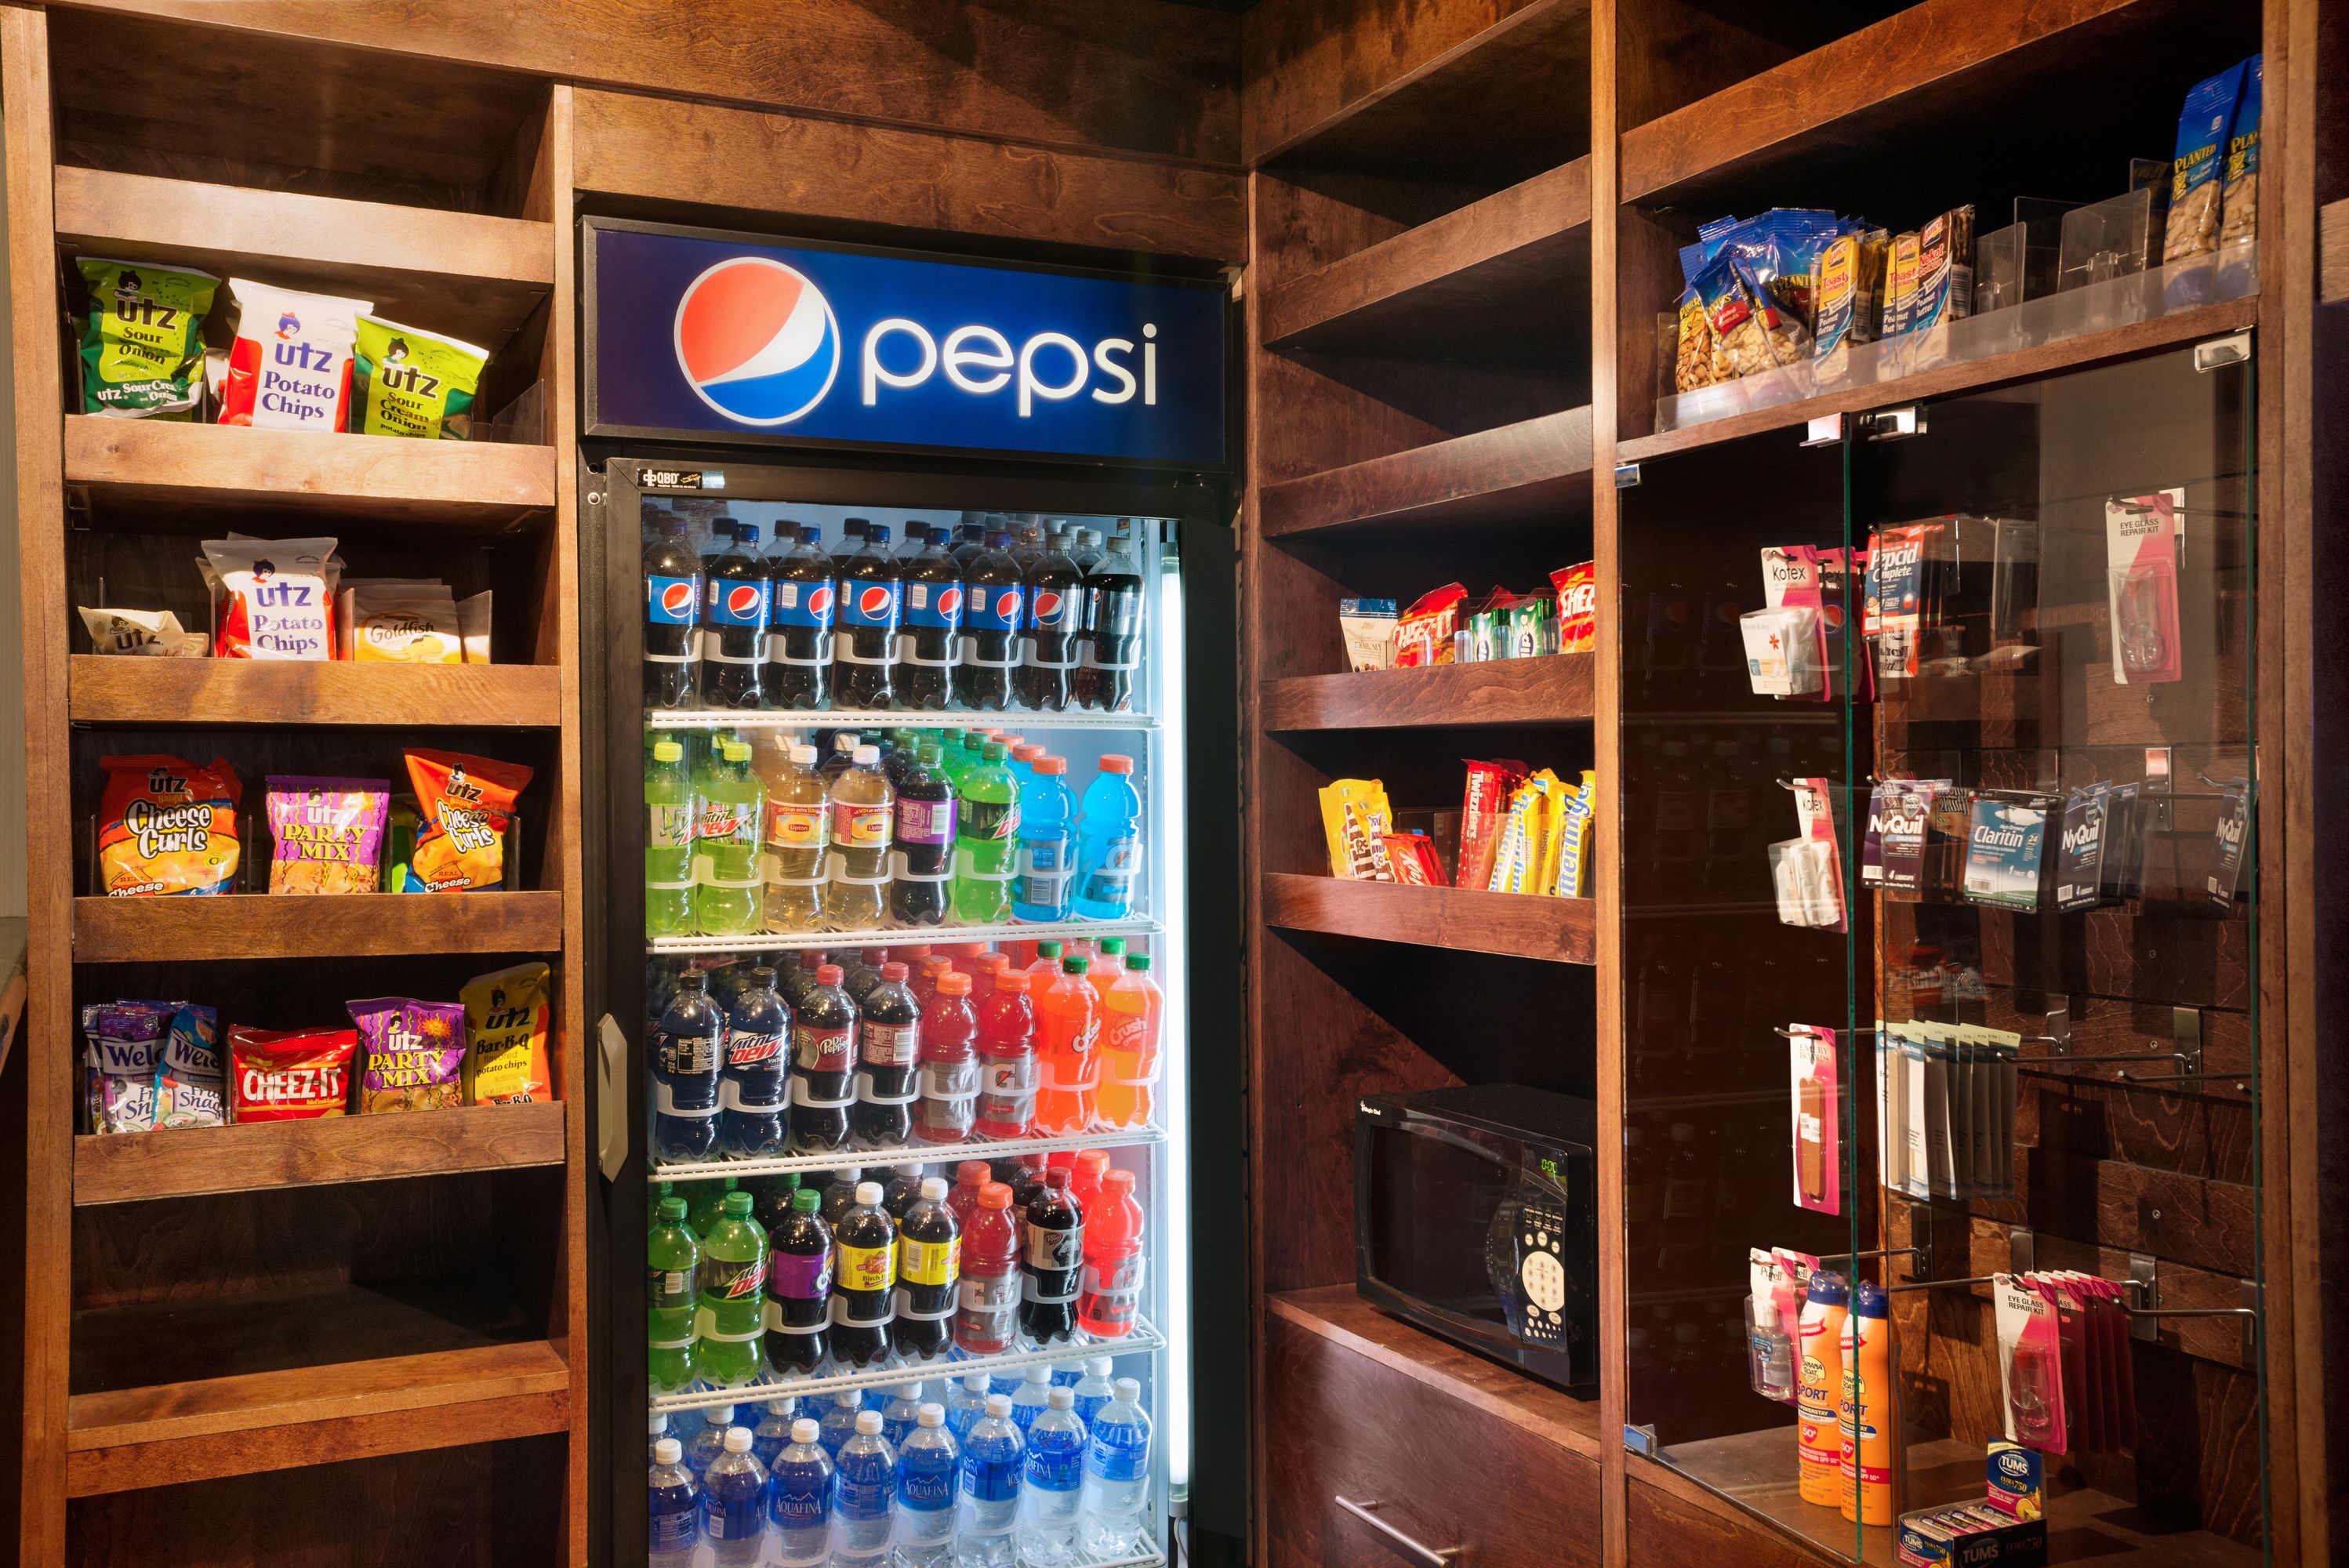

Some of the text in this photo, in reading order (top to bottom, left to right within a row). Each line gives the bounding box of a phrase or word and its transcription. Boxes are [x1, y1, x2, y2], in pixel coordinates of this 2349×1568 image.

[1919, 243, 1944, 265] Nekot
[1823, 271, 1849, 287] Toasty
[116, 298, 178, 330] utz
[1819, 314, 1839, 325] Peanut
[123, 326, 163, 343] Sour
[1817, 324, 1835, 336] Butter
[119, 343, 165, 365] Onion
[274, 342, 332, 373] utz
[862, 317, 1158, 418] pepsi
[122, 383, 151, 393] Sour
[263, 370, 336, 399] Potato
[382, 366, 441, 399] utz
[97, 388, 122, 401] utz
[148, 391, 178, 402] Onion
[388, 392, 424, 410] Sour
[262, 392, 325, 421] Chips
[379, 400, 430, 423] Cream
[380, 410, 427, 430] Onion
[380, 423, 405, 435] potato
[656, 472, 678, 485] QBD
[2120, 518, 2159, 529] EYE GLASS
[2120, 525, 2159, 537] REPAIR KIT
[1872, 567, 1912, 583] Cmplete
[256, 582, 312, 607] utz
[252, 614, 323, 632] Potato
[370, 620, 435, 644] Goldfish
[1393, 609, 1457, 649] CHEEZ-IT
[114, 628, 162, 650] utz
[256, 634, 318, 654] Chips
[149, 775, 189, 793] utz
[445, 782, 484, 803] utz
[1467, 770, 1485, 839] Twizzlers
[126, 799, 212, 834] Cheese
[437, 799, 491, 832] Cheese
[1869, 814, 1925, 835] NyQuil
[283, 824, 368, 844] PARTY
[448, 825, 496, 854] Curls
[1974, 826, 2024, 848] Claritin
[2062, 818, 2100, 854] NyQuil
[2216, 817, 2243, 845] NyQuil
[138, 826, 208, 859] Curls
[298, 842, 350, 861] MIX
[1889, 870, 1895, 880] 4
[108, 882, 164, 897] Cheese
[425, 877, 471, 893] Cheese
[485, 1006, 531, 1030] utz
[388, 1030, 423, 1051] utz
[832, 1036, 844, 1045] Dr
[1109, 1018, 1148, 1046] Crush
[824, 1039, 850, 1054] Pepper
[1799, 1044, 1828, 1055] EMERY
[368, 1050, 447, 1071] PARTY
[484, 1050, 518, 1064] flavored
[477, 1064, 503, 1078] potato
[504, 1059, 528, 1072] chips
[992, 1063, 1016, 1090] G
[243, 1067, 342, 1102] CHEEZ-IT
[381, 1068, 432, 1089] MIX
[2008, 1294, 2044, 1308] EYE GLASS
[2008, 1302, 2044, 1316] REPAIR KIT
[1803, 1367, 1817, 1376] BOAT
[1802, 1427, 1817, 1437] 50+
[1840, 1442, 1853, 1453] 50+
[2001, 1455, 2028, 1474] TUMS
[904, 1479, 949, 1497] AQUAFINA
[2000, 1475, 2028, 1493] EXTRA 750
[775, 1497, 822, 1517] AQUAFINA
[1904, 1534, 1923, 1549] TUMS
[1924, 1541, 1946, 1555] EXTRA 750
[1962, 1544, 1999, 1563] TUMS
